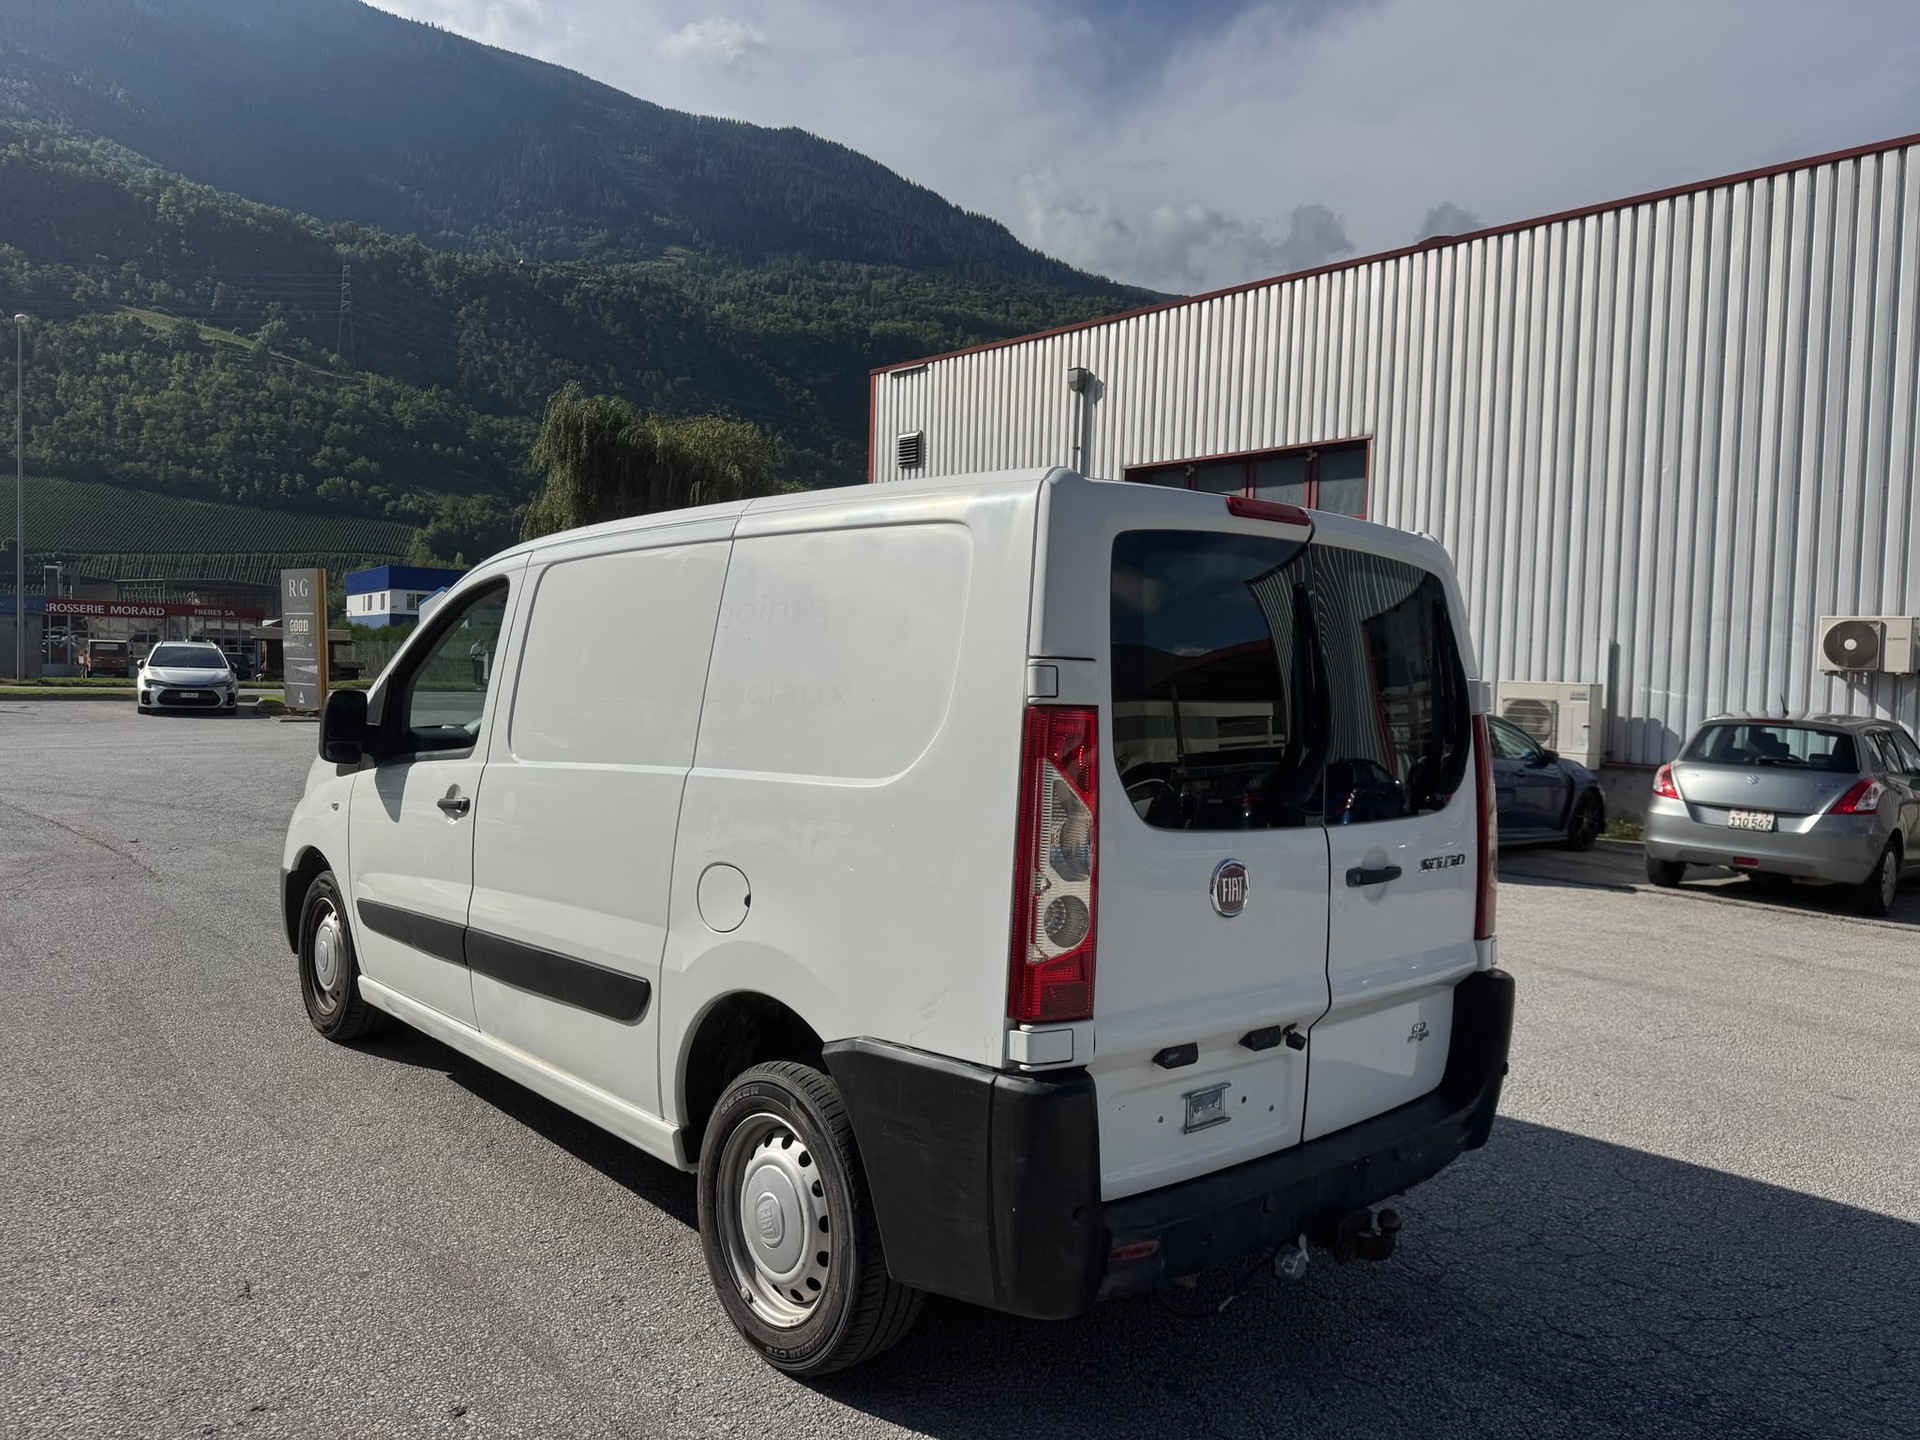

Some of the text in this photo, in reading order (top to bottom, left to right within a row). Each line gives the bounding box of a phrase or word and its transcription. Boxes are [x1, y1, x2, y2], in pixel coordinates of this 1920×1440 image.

[110, 605, 165, 616] MORARD
[224, 609, 235, 617] SA
[1222, 876, 1244, 903] FIAT
[720, 1086, 759, 1115] NEXEN
